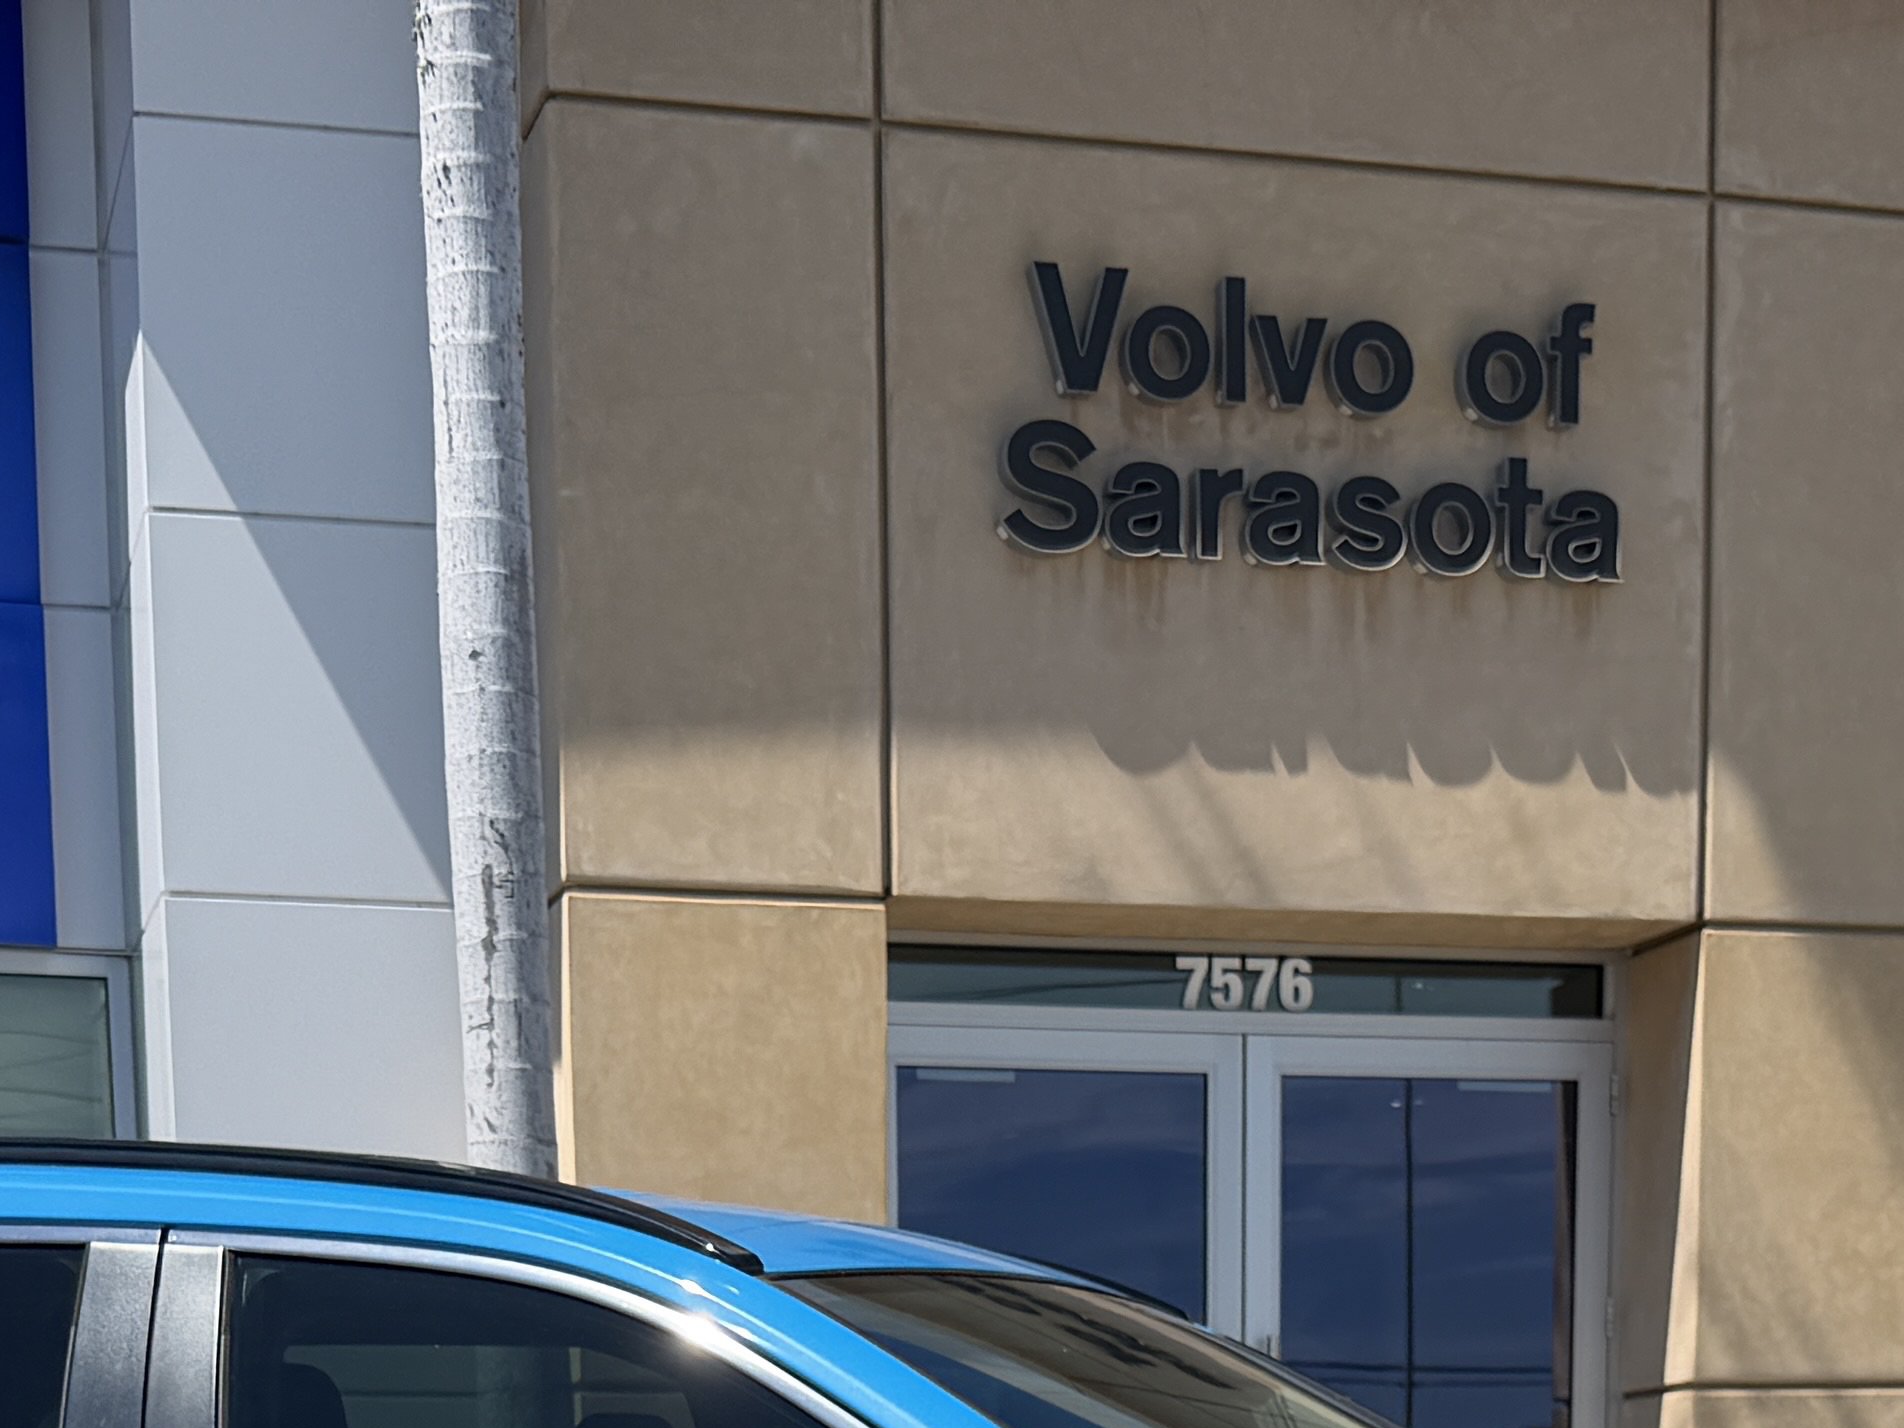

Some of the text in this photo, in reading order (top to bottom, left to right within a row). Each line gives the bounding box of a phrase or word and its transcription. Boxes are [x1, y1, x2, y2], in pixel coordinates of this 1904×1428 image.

[1028, 260, 1596, 430] Volvo of
[996, 419, 1625, 584] Sarasota
[1175, 955, 1314, 1012] 7576
